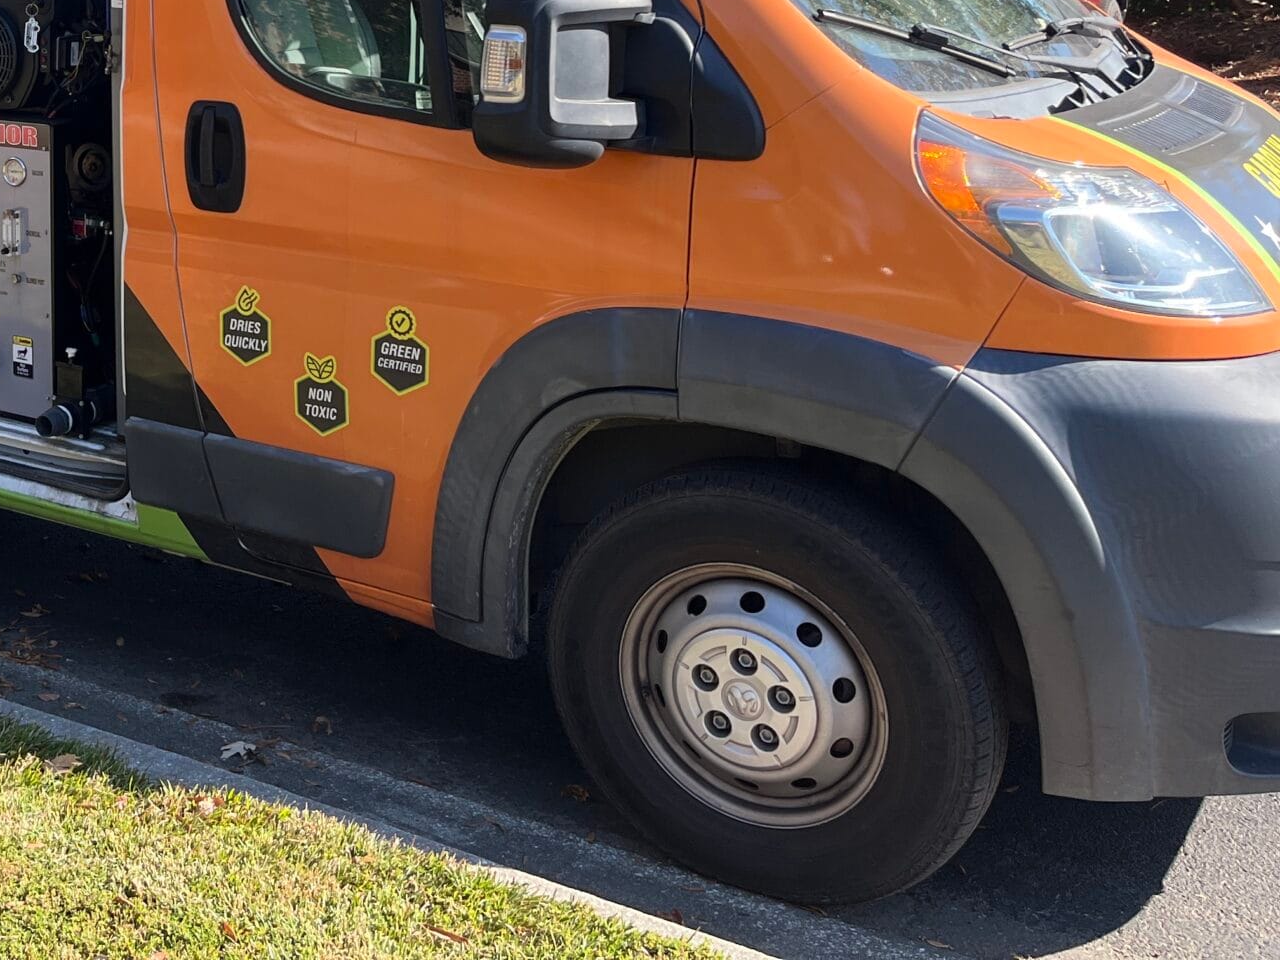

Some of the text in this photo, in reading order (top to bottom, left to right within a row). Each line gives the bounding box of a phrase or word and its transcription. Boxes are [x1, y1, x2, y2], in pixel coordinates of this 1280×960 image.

[229, 318, 262, 334] DRIES
[224, 334, 268, 353] QUICKLY
[380, 341, 421, 361] GREEN
[377, 357, 423, 375] CERTIFIED
[308, 387, 332, 403] NON
[304, 403, 338, 421] TOXIC
